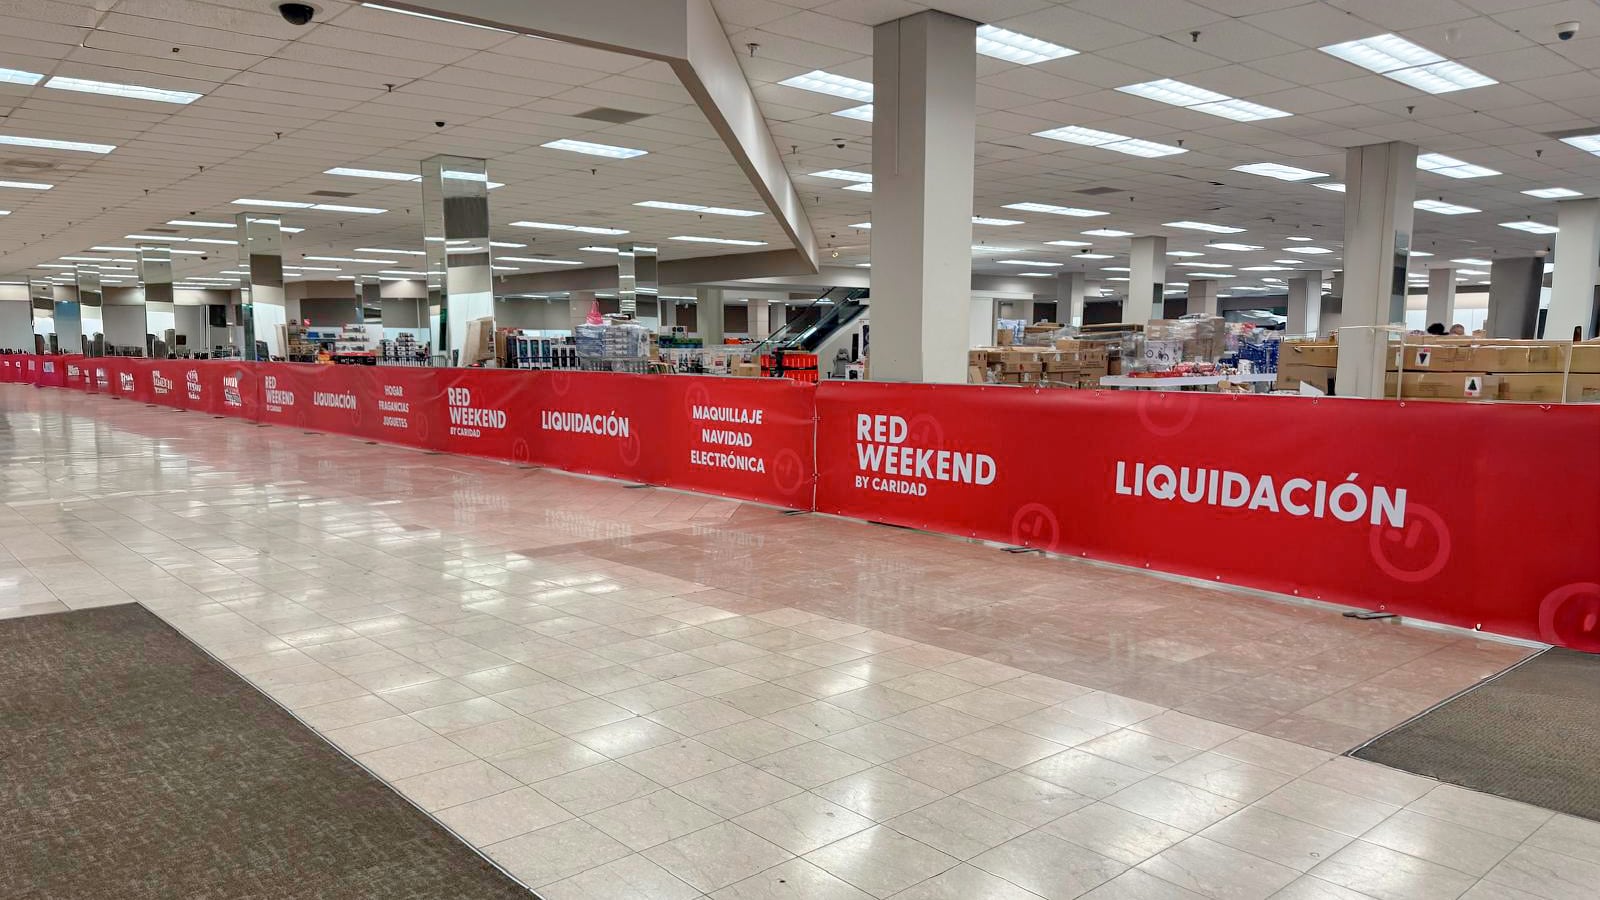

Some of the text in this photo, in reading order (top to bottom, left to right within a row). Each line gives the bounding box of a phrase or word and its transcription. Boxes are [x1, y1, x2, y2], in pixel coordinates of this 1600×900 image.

[264, 375, 277, 390] RED
[384, 385, 403, 397] HOGAR
[265, 389, 295, 407] WEEKEND
[313, 390, 357, 411] LIQUIDACIÓN
[378, 400, 409, 413] FRAGANCIAS
[447, 387, 471, 407] RED
[383, 416, 408, 428] JUGUETES
[449, 406, 507, 429] WEEKEND
[541, 409, 629, 438] LIQUIDACIÓN
[692, 405, 763, 425] MAQUILLAJE
[450, 426, 481, 438] BY CARIDAD
[702, 428, 753, 447] NAVIDAD
[857, 413, 908, 444] RED
[690, 449, 765, 474] ELECTRÓNICA
[856, 442, 996, 485] WEEKEND
[855, 475, 927, 497] BY CARIDAD
[1115, 461, 1407, 528] LIQUIDACIÓN
